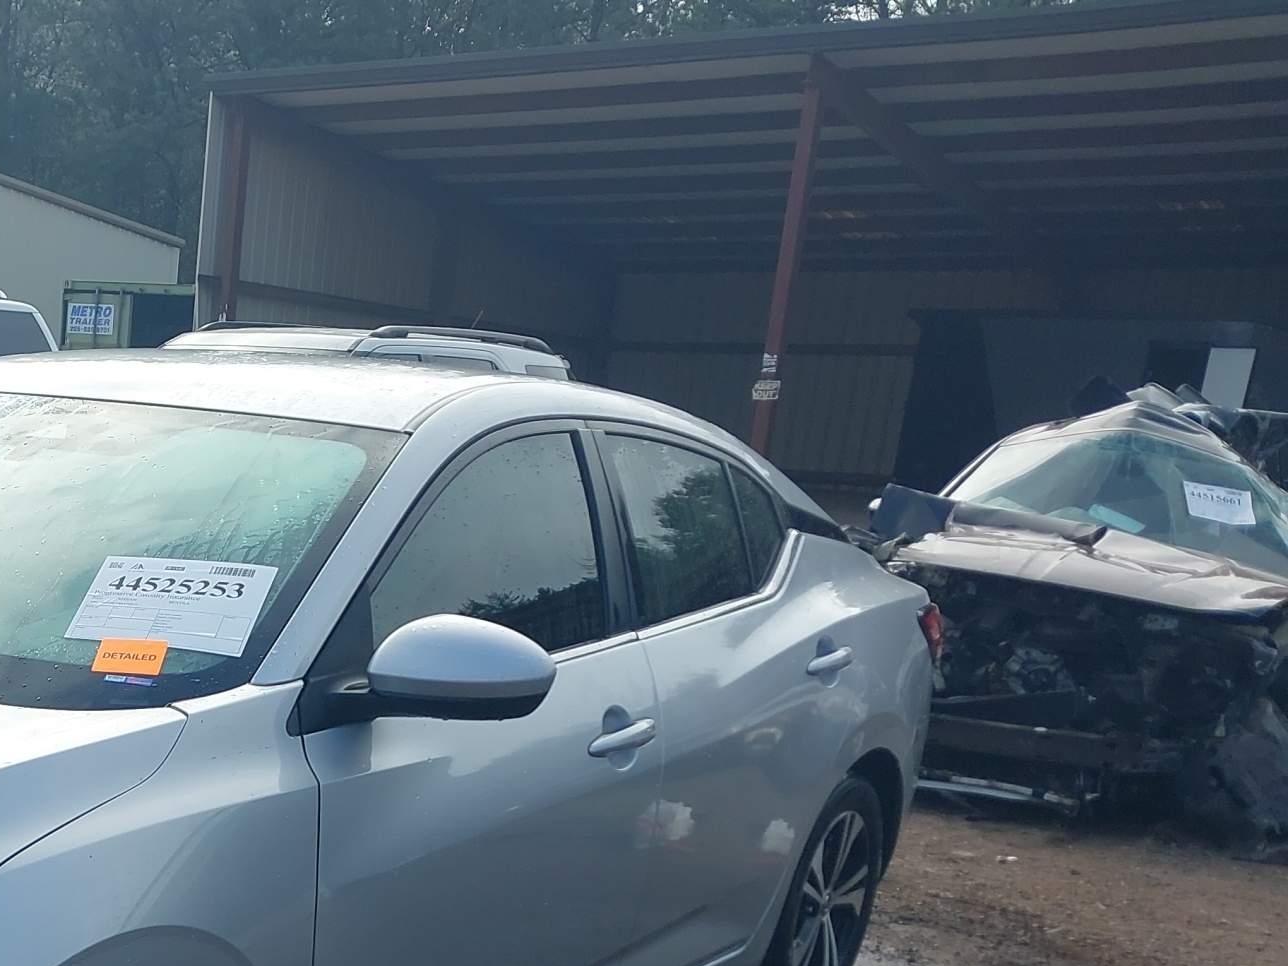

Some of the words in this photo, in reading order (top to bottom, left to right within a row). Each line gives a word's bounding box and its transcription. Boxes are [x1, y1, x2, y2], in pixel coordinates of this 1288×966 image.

[71, 305, 112, 318] METRO
[108, 575, 245, 599] 44525253
[102, 651, 157, 662] DETAILED
